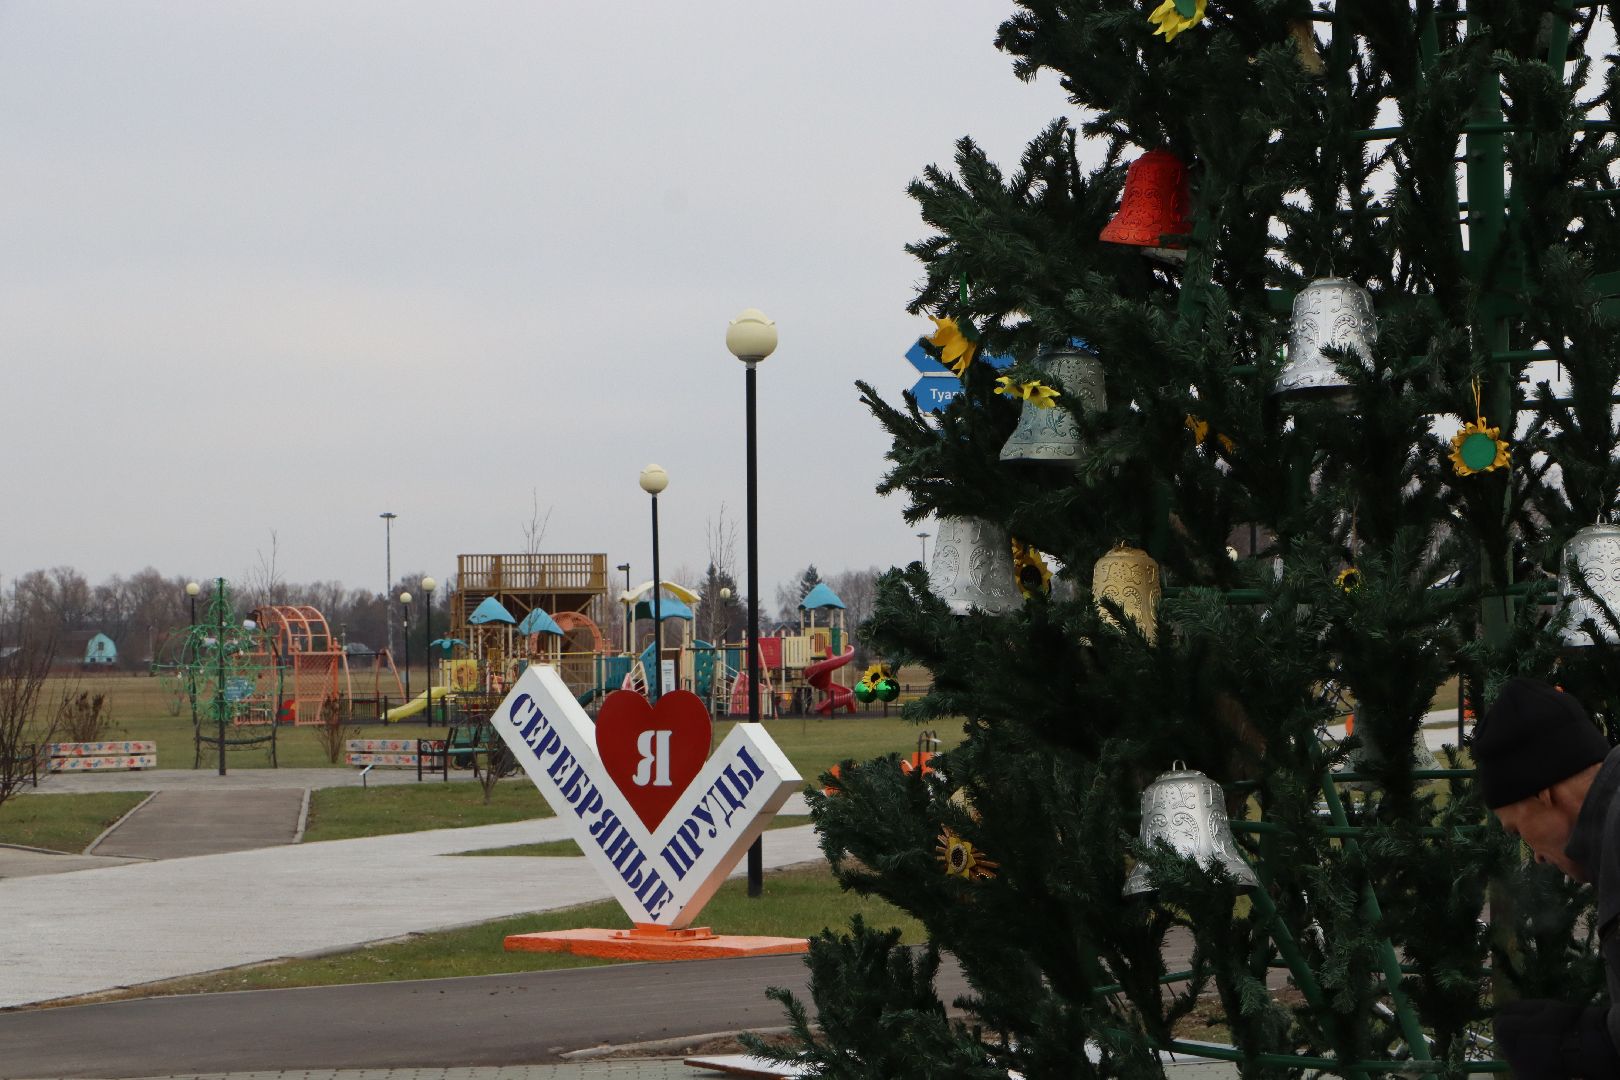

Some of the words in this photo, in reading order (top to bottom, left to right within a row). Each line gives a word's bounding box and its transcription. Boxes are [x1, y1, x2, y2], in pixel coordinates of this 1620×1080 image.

[509, 693, 674, 921] СЕРЕБРЯНЫЕ
[632, 730, 673, 786] Я
[660, 745, 765, 881] ПРУДЫ
